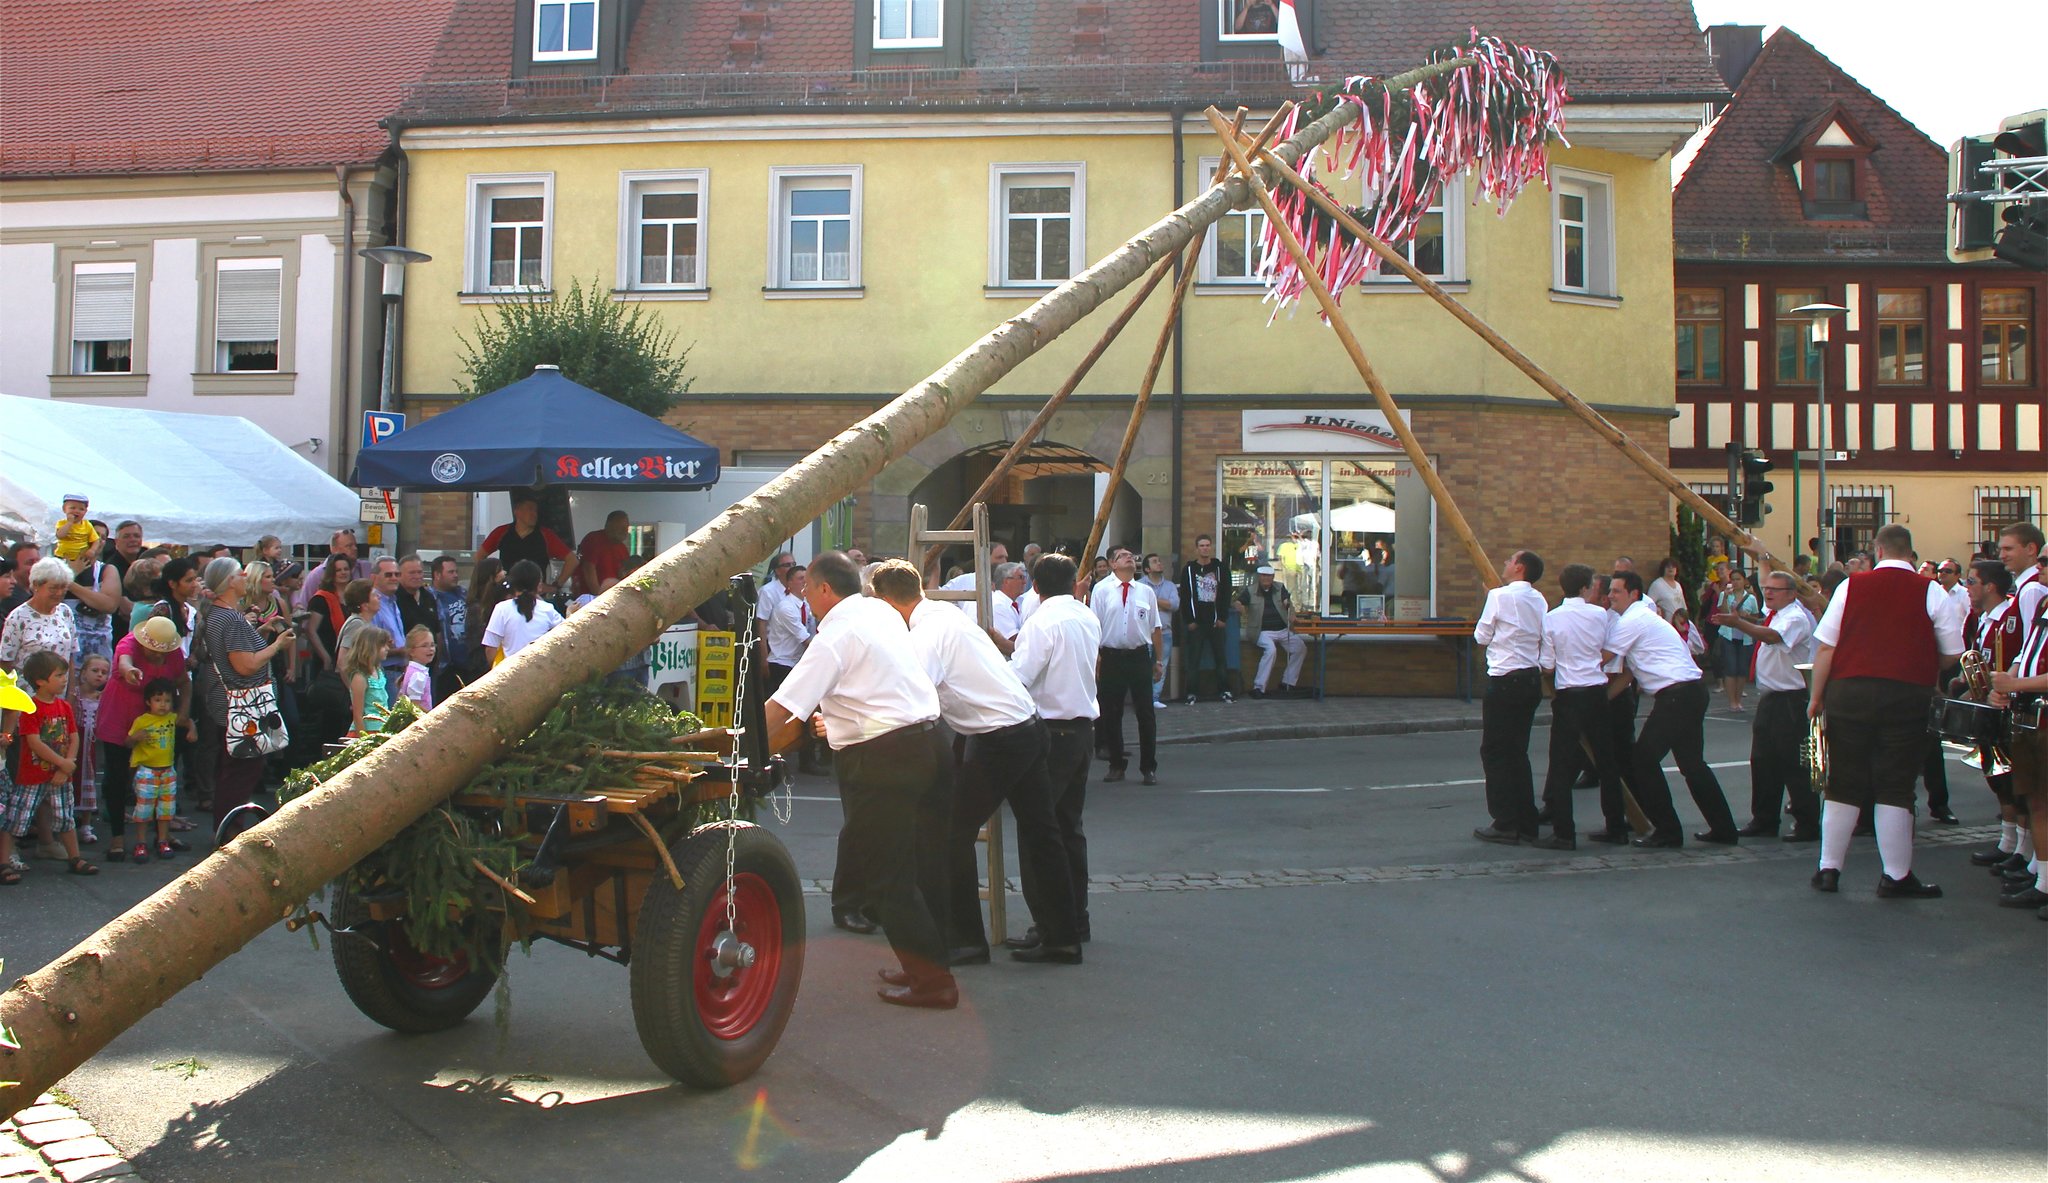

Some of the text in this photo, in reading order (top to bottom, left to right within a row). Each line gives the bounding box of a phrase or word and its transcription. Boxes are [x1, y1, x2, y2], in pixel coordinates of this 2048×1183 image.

[374, 417, 395, 438] P
[556, 455, 701, 479] KellerBier
[1230, 467, 1412, 478] Die Fahrschule in Baiersdorf
[1147, 471, 1168, 486] 28
